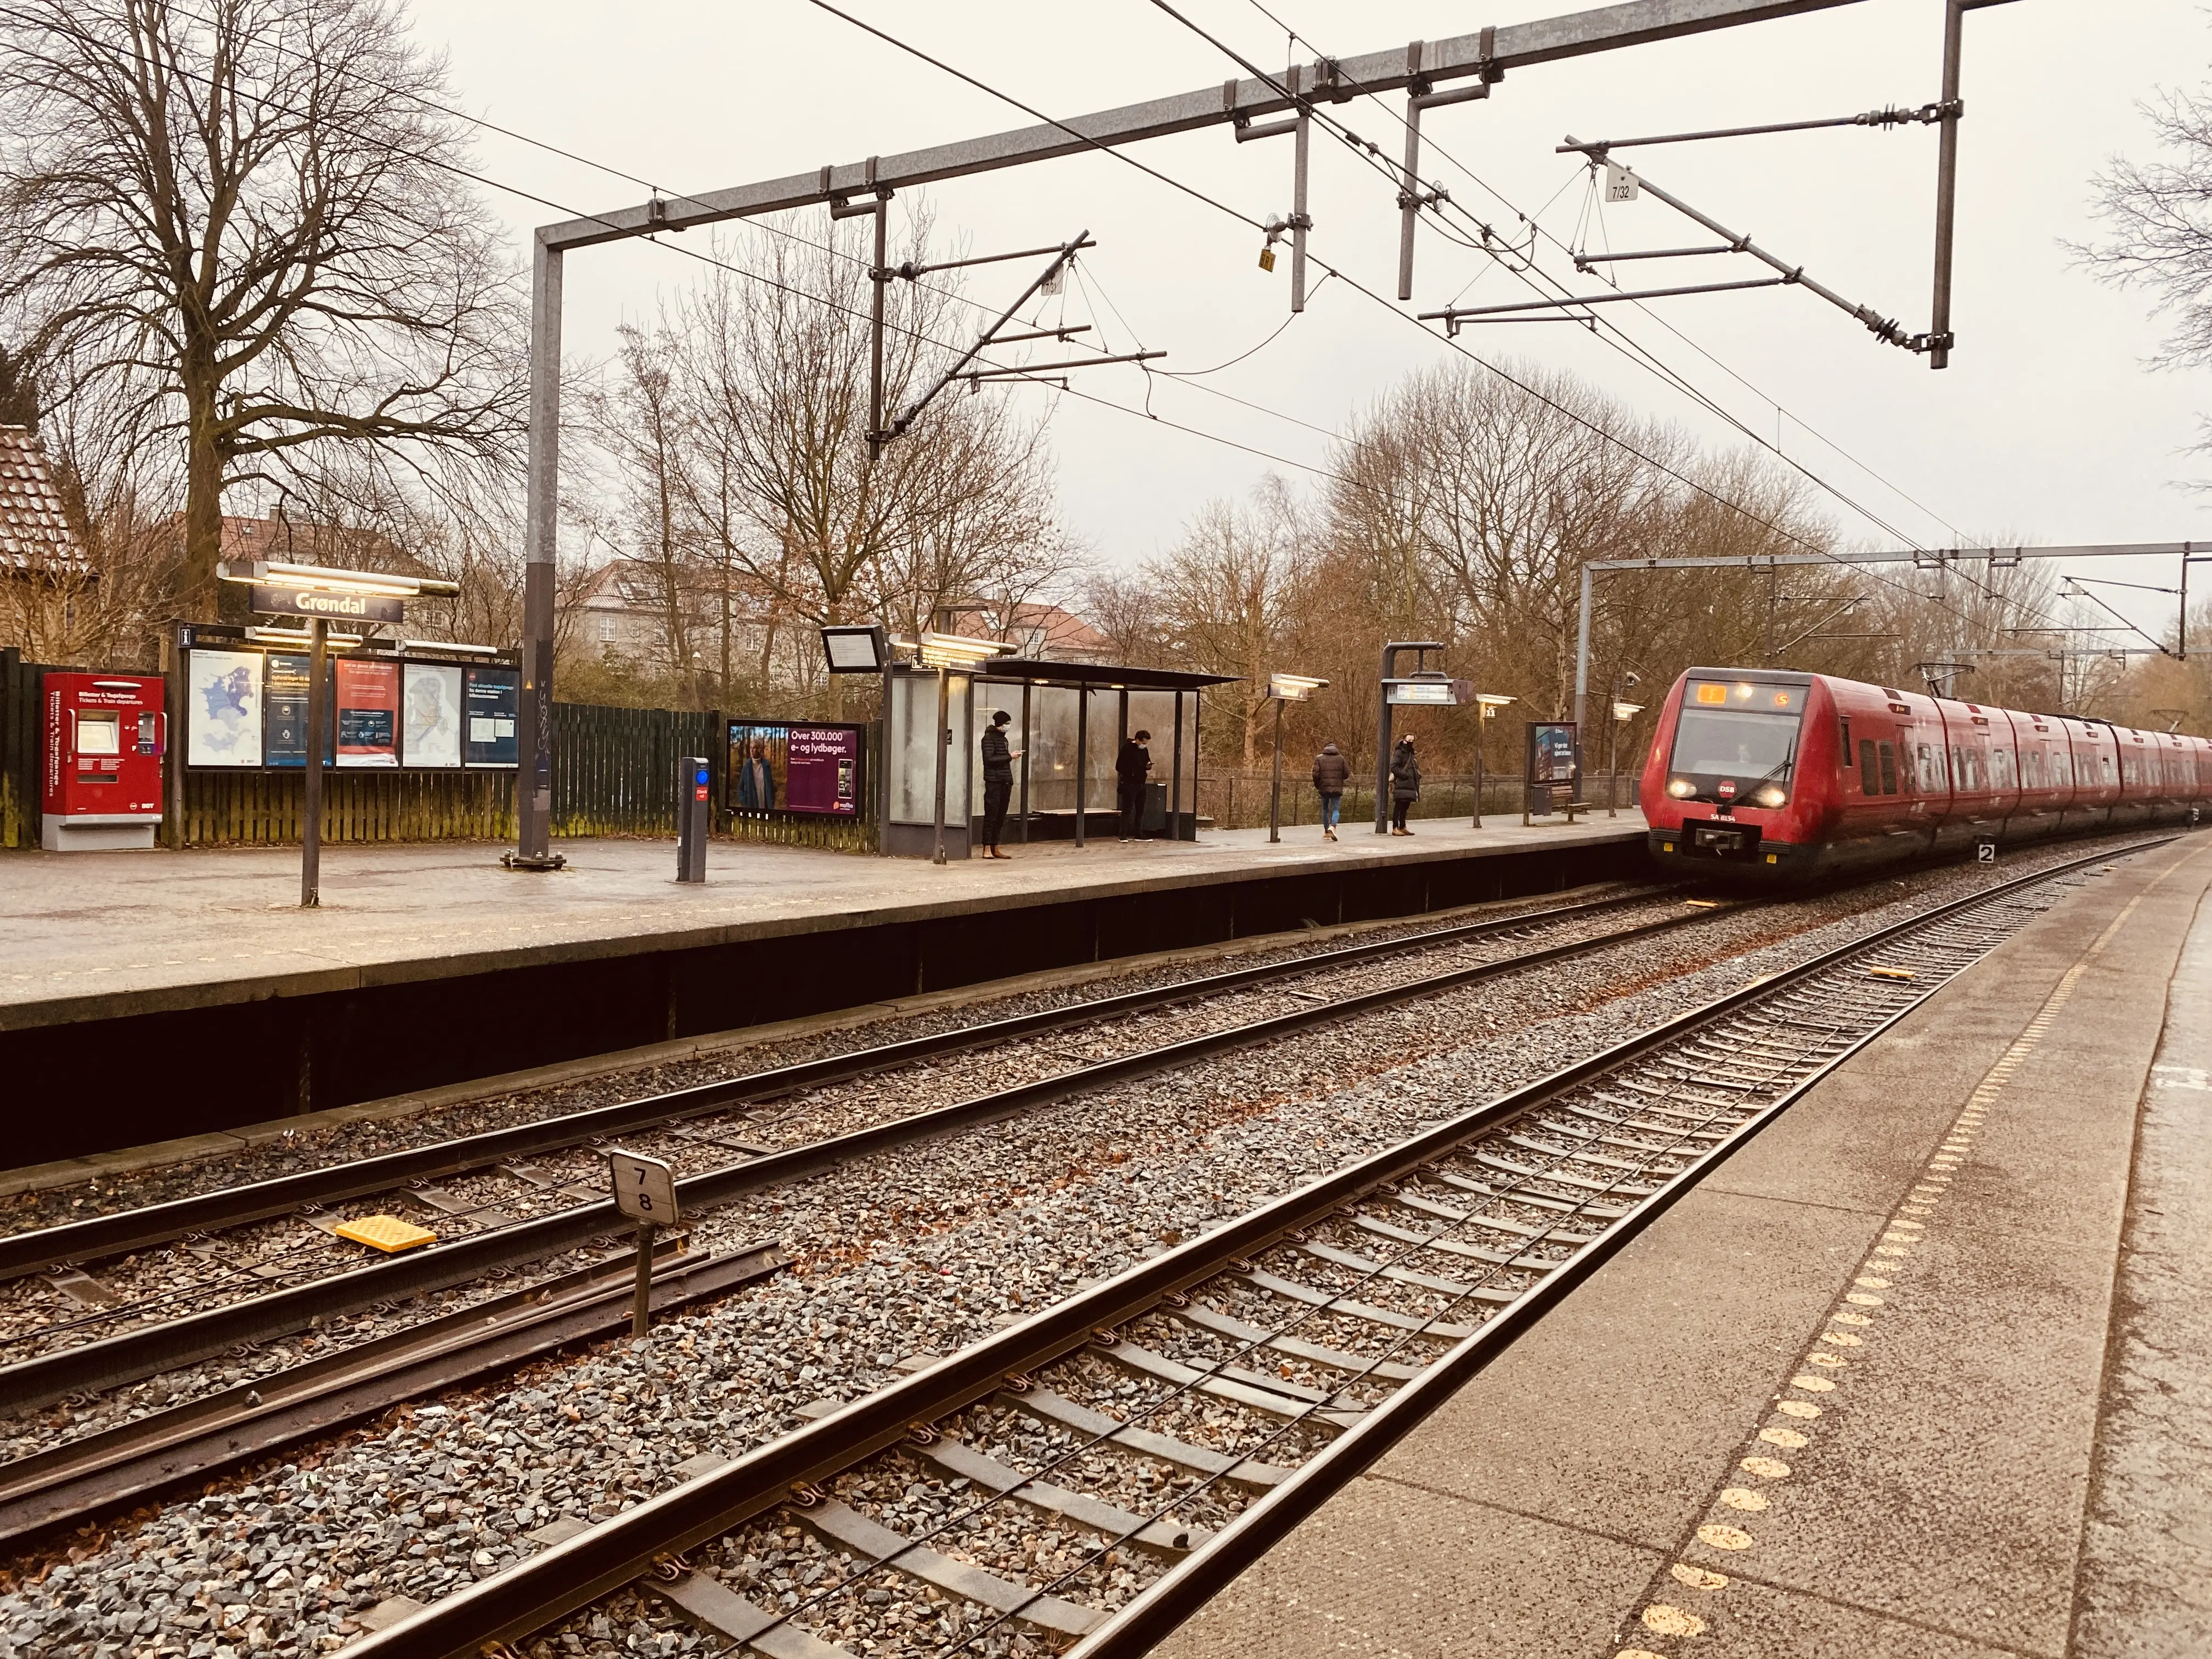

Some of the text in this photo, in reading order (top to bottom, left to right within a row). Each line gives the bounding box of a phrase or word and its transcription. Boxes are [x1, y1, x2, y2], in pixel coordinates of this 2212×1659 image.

[1612, 185, 1629, 199] 7/32
[296, 592, 366, 614] Grøndal
[1779, 696, 1789, 704] S
[791, 730, 843, 741] Over 300.000
[800, 745, 810, 754] og
[811, 742, 847, 755] lydbøger.
[1980, 846, 1993, 862] 2
[634, 1167, 646, 1186] 7
[639, 1193, 653, 1211] 8
